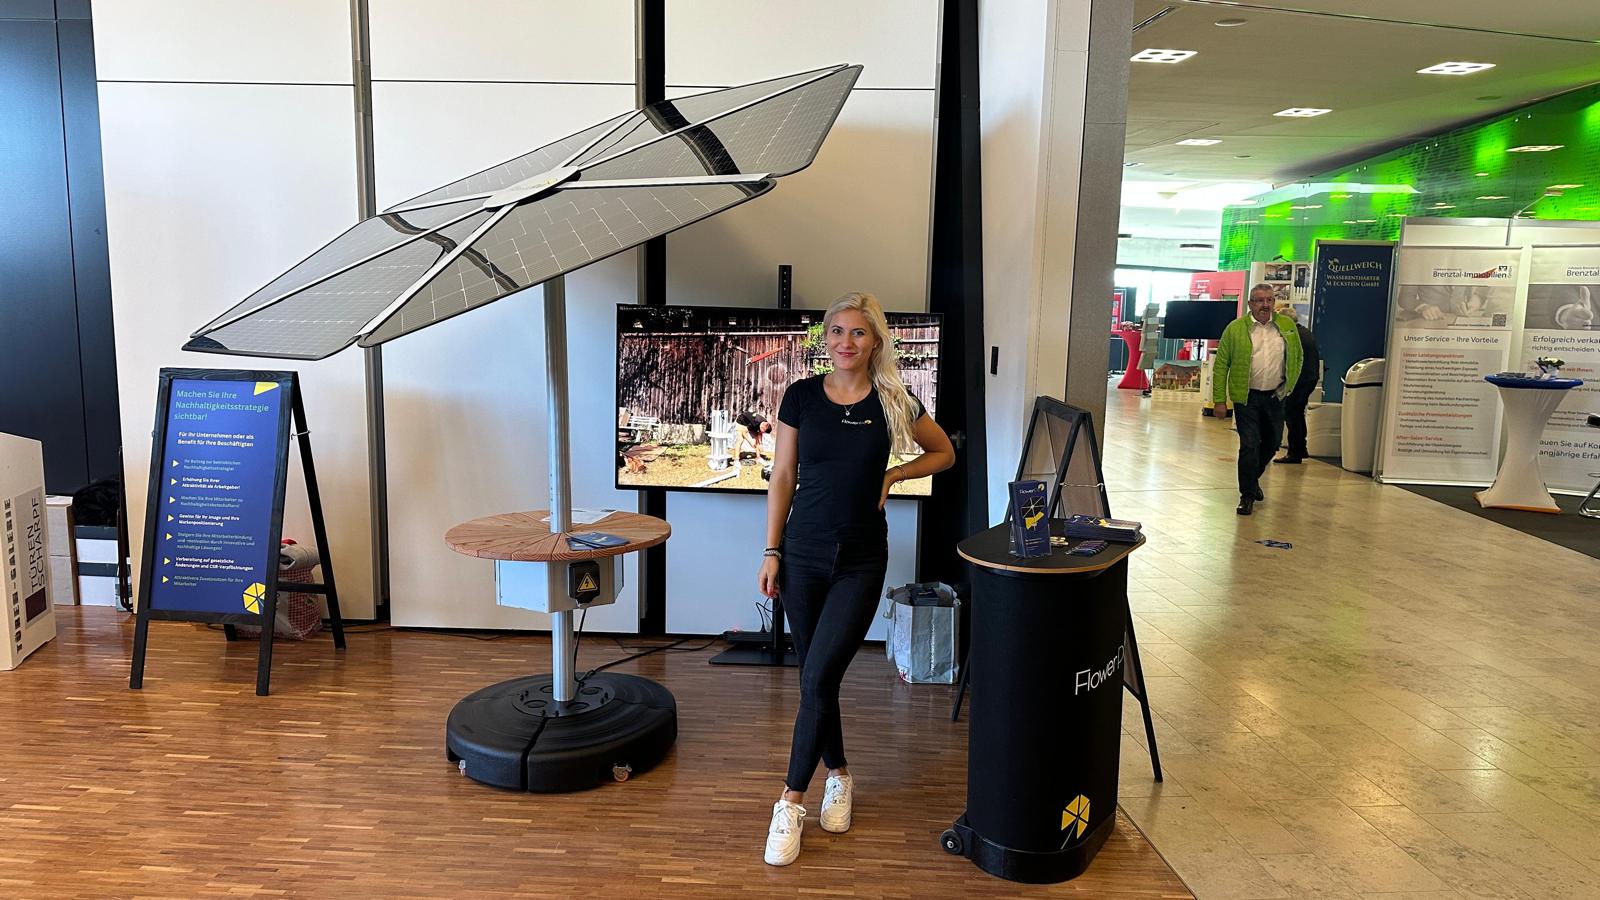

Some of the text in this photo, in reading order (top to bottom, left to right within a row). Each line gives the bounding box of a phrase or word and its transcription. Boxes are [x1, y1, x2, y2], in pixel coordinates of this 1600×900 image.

[1327, 261, 1382, 272] QUELLWEICH
[1533, 335, 1576, 344] Erfolgreich
[176, 390, 237, 399] Machen Sie Ihre
[175, 401, 269, 413] Nachhaltigkeitsstrategie
[174, 413, 208, 421] sichtbar!
[217, 440, 254, 448] Beschäftigten
[1573, 441, 1587, 449] auf
[1539, 449, 1581, 459] angjährige
[27, 525, 38, 594] TÜREN
